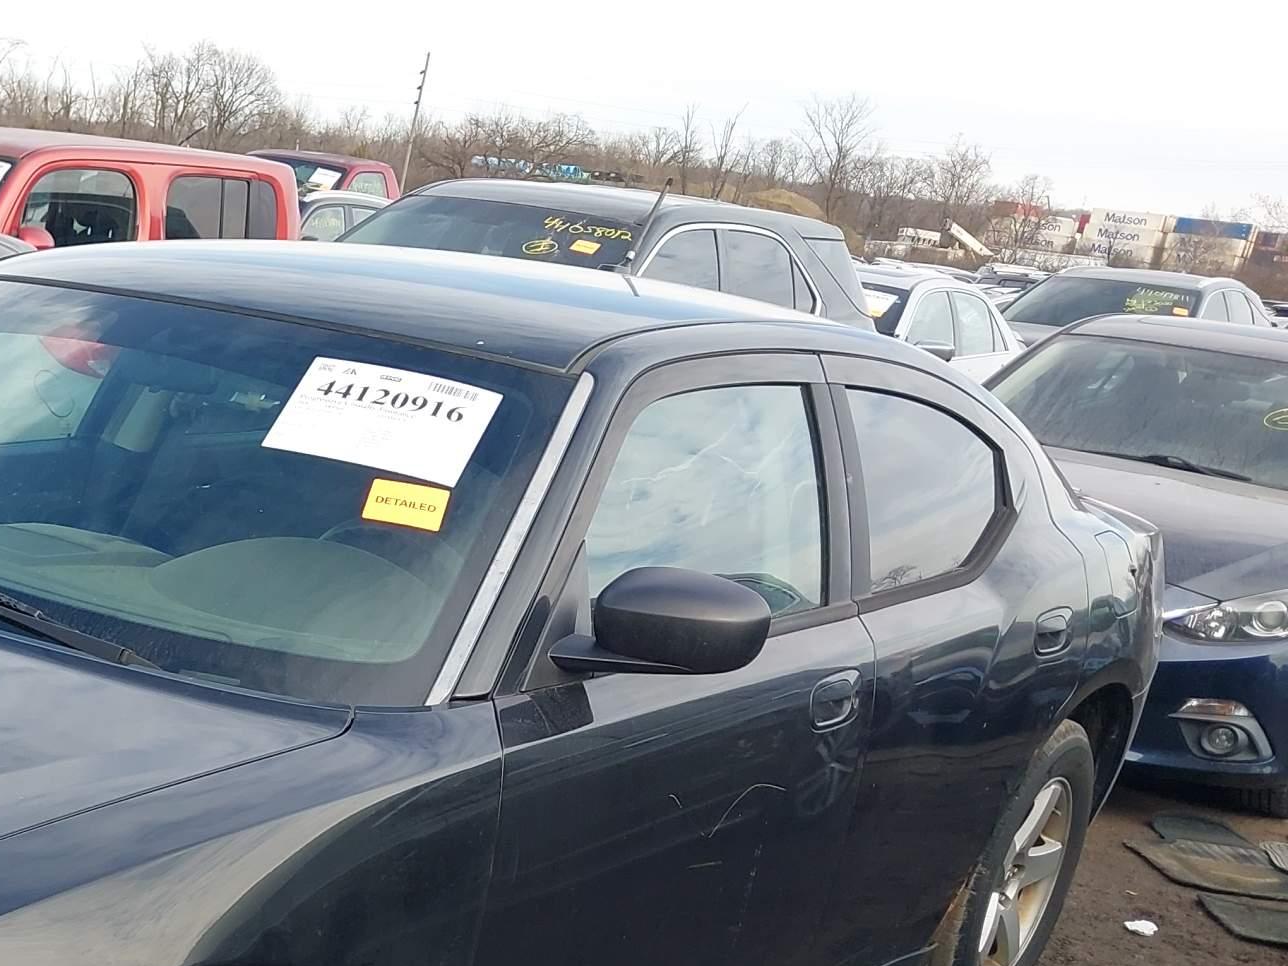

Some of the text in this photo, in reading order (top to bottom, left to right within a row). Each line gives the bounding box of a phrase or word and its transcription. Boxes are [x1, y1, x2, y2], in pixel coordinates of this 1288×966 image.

[1104, 212, 1147, 226] Matson
[1097, 228, 1140, 242] Matson
[316, 379, 468, 423] 44120916
[375, 495, 437, 513] DETAILED
